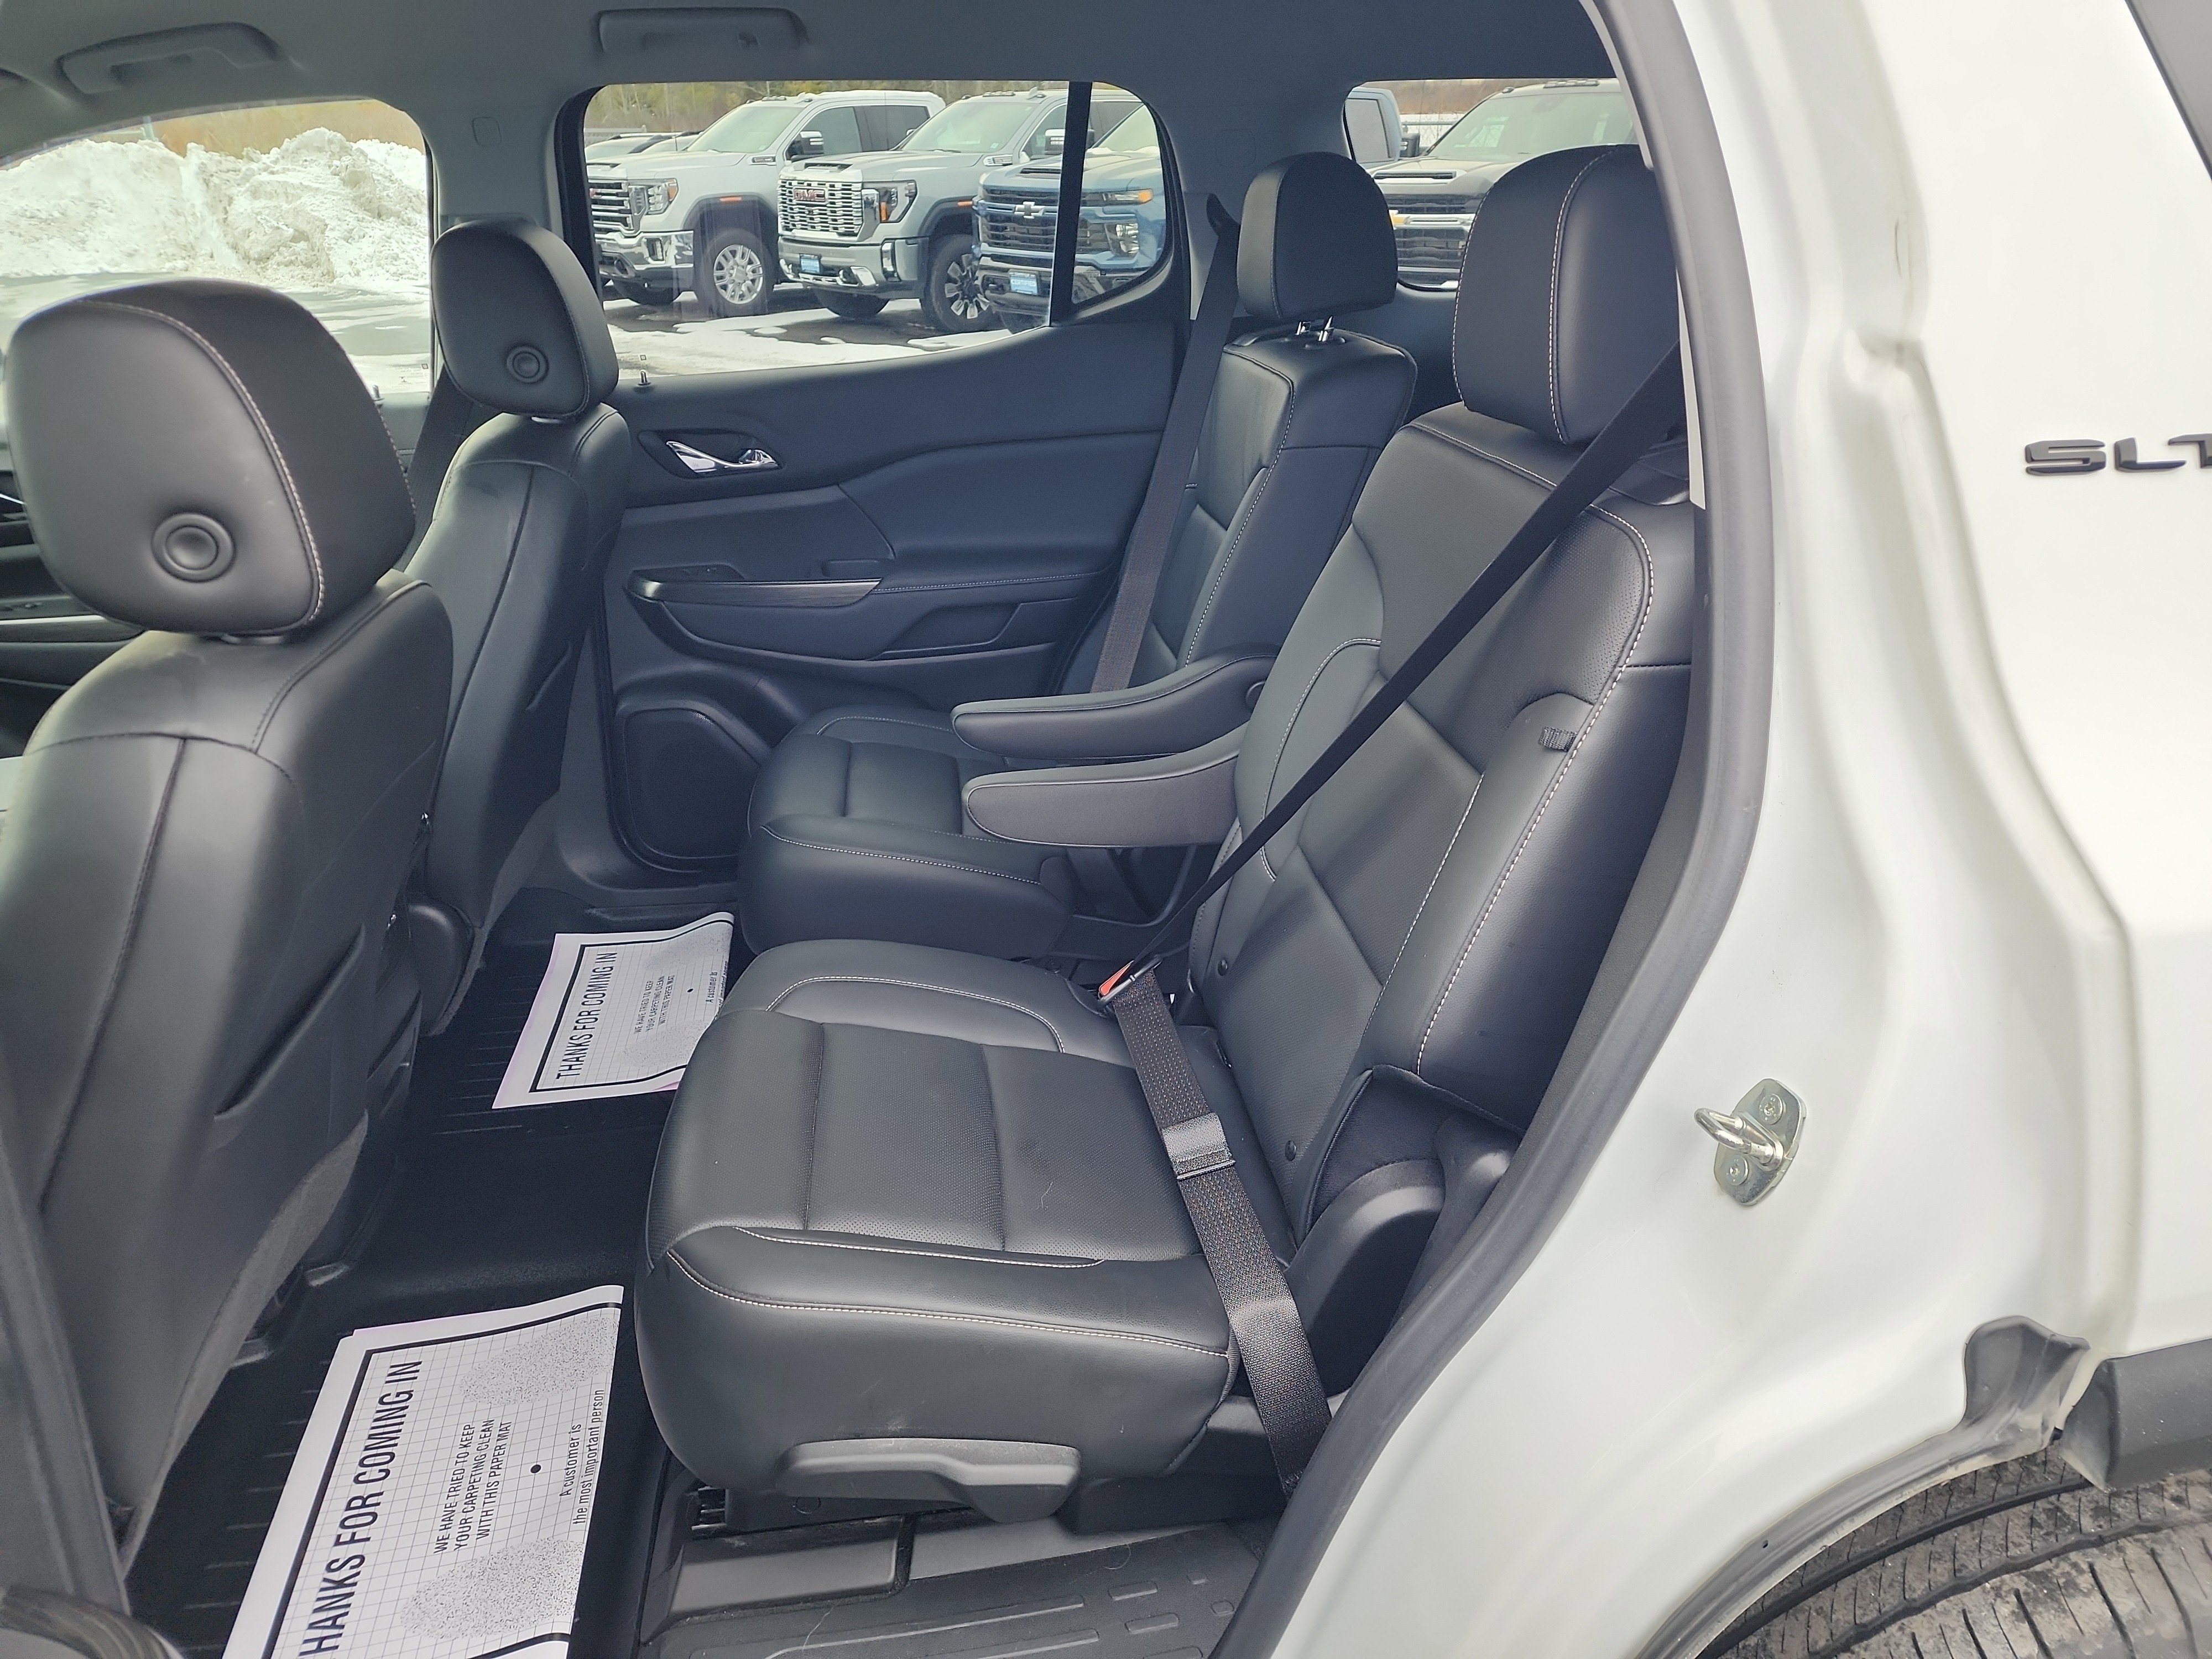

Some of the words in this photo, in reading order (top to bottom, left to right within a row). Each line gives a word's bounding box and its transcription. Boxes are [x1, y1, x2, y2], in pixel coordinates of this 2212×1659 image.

[794, 189, 826, 201] GMC
[2025, 434, 2212, 476] SLT
[595, 952, 618, 963] IN
[581, 966, 614, 1006] COMING
[645, 980, 654, 992] KEEP
[655, 975, 665, 991] CLEAN
[663, 985, 673, 1000] PAPER
[667, 975, 675, 985] MAT
[707, 977, 717, 998] customer
[639, 998, 649, 1013] TRIED
[649, 990, 662, 1017] CARPETING
[660, 1000, 670, 1011] THIS
[573, 1009, 601, 1031] FOR
[634, 1025, 643, 1034] WE
[636, 1012, 646, 1025] HAVE
[645, 1017, 656, 1032] YOUR
[658, 1011, 667, 1026] WITH
[556, 1034, 593, 1079] THANKS
[385, 1360, 423, 1385] IN
[591, 1390, 604, 1423] person
[353, 1389, 414, 1485] COMING
[458, 1424, 476, 1449] KEEP
[476, 1419, 495, 1452] CLEAN
[497, 1421, 512, 1442] MAT
[568, 1424, 582, 1434] is
[455, 1452, 469, 1466] TO
[488, 1443, 507, 1478] PAPER
[564, 1437, 580, 1487] customer
[581, 1426, 600, 1478] important
[446, 1468, 466, 1500] TRIED
[462, 1453, 487, 1514] CARPETING
[482, 1480, 500, 1507] THIS
[559, 1488, 572, 1497] A
[578, 1478, 593, 1504] most
[333, 1491, 385, 1547] FOR
[439, 1501, 458, 1532] HAVE
[476, 1509, 494, 1540] WITH
[572, 1507, 588, 1525] the
[433, 1533, 451, 1554] WE
[453, 1516, 473, 1551] YOUR
[298, 1554, 366, 1659] HANKS
